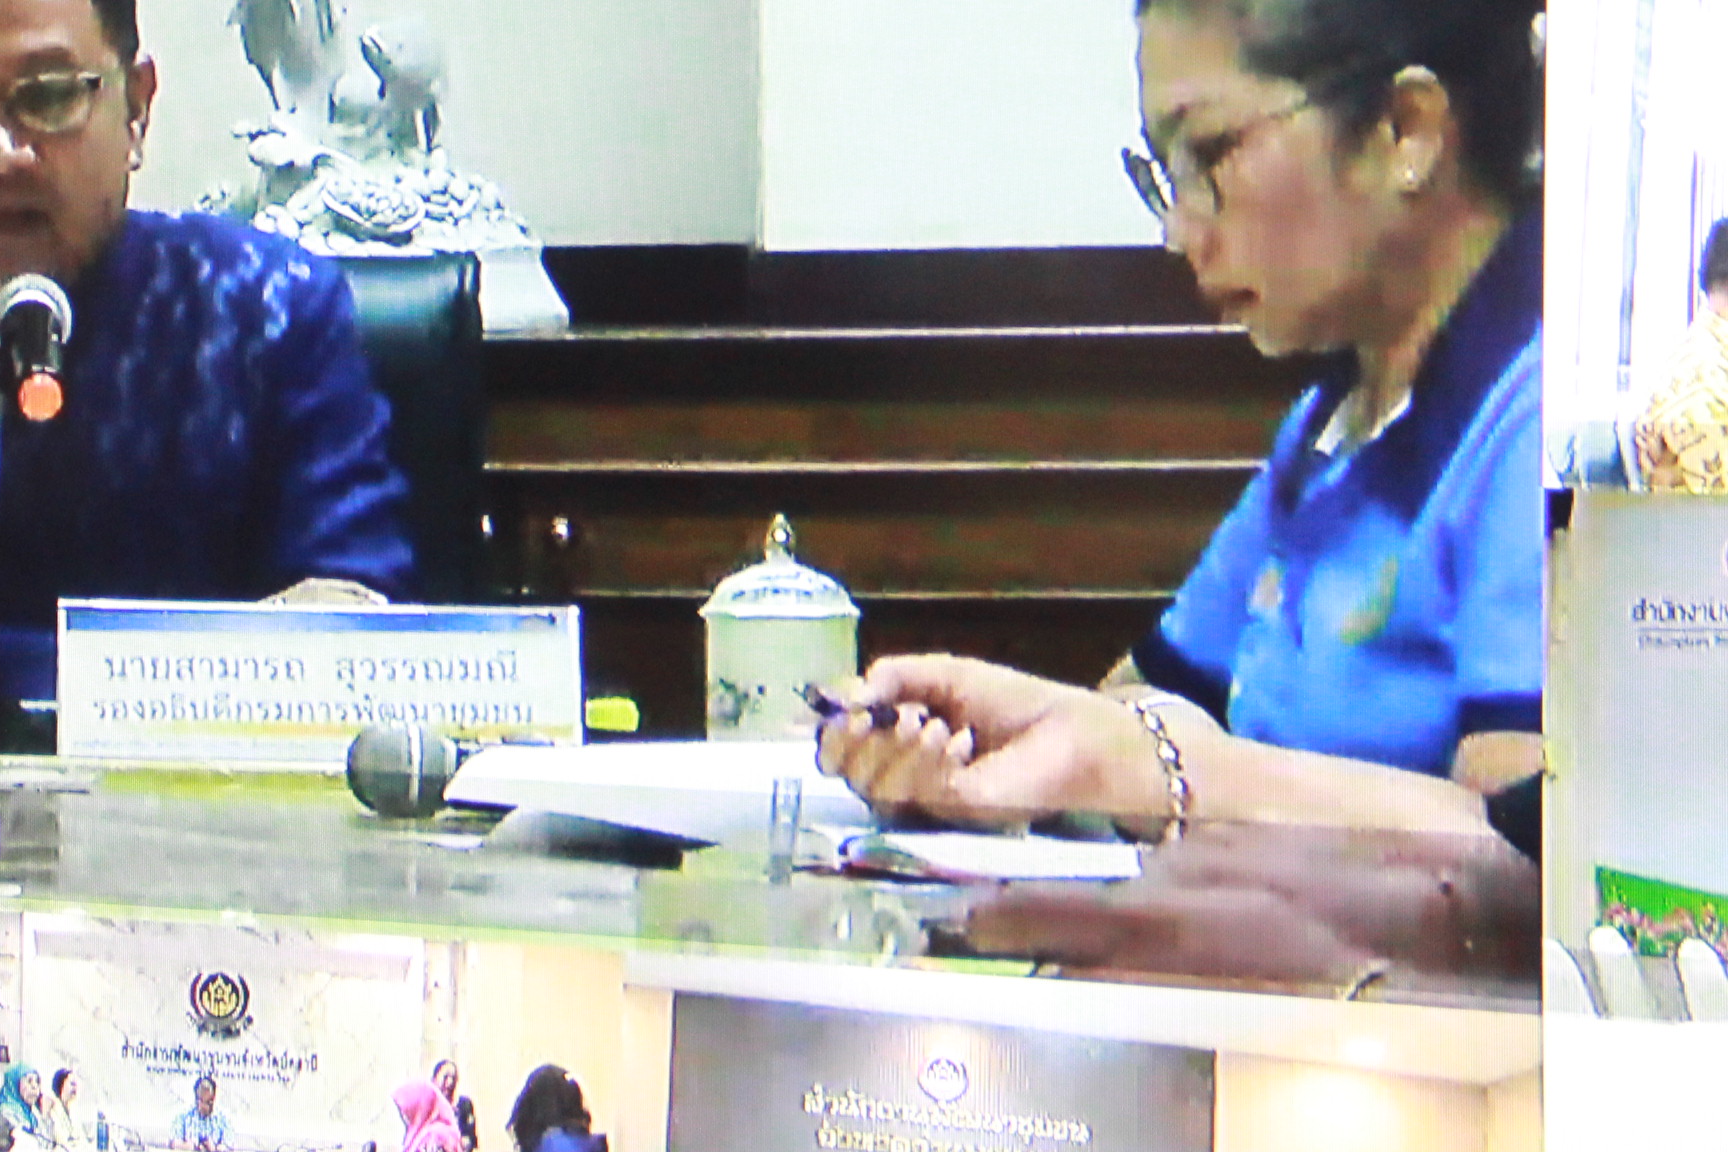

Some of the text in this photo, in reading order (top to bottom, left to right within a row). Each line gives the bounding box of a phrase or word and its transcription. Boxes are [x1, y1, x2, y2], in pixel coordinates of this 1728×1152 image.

[104, 649, 519, 691] นายสามารถ สุวรรณมณี
